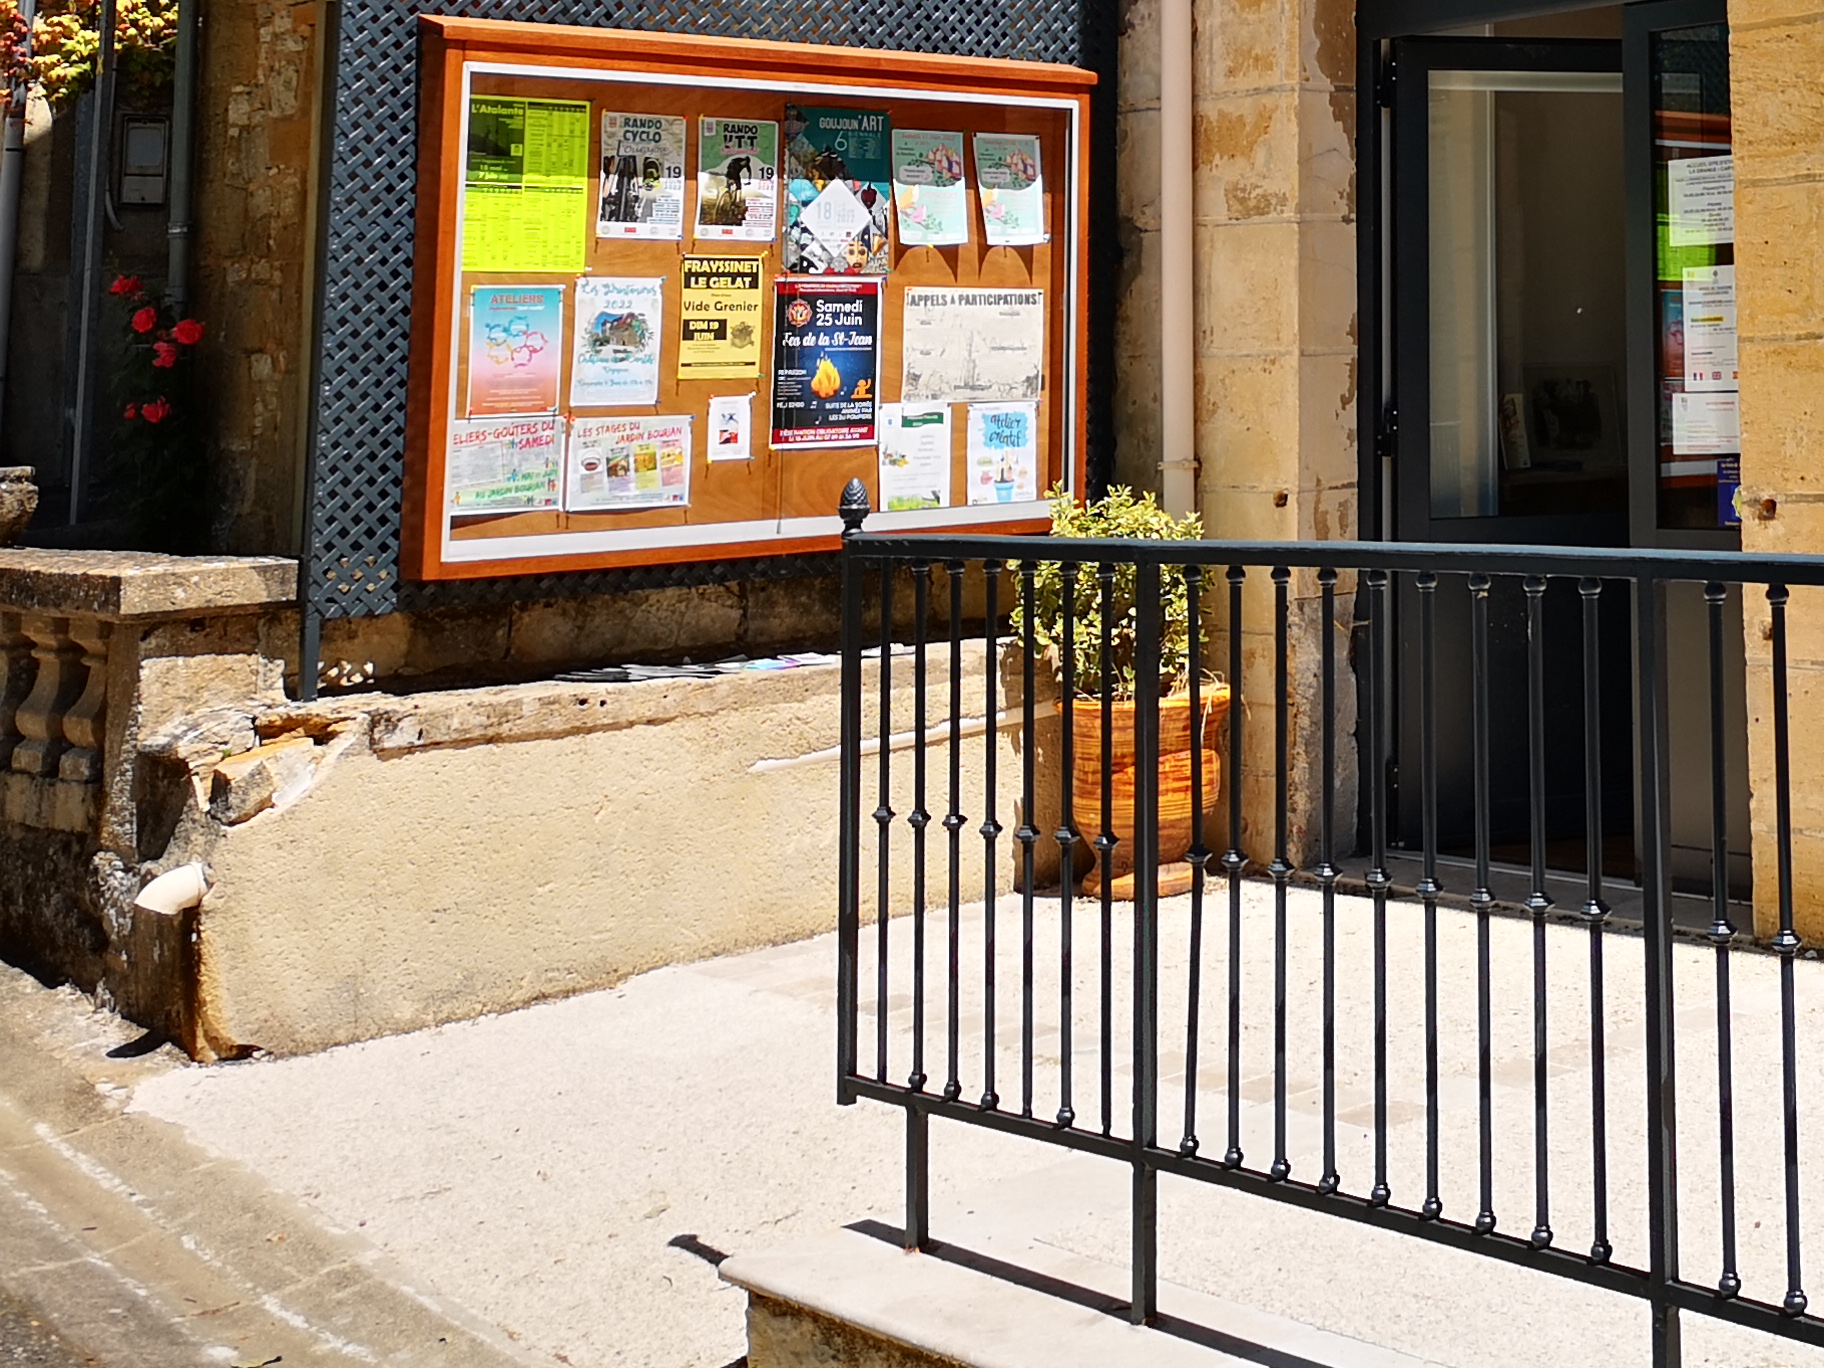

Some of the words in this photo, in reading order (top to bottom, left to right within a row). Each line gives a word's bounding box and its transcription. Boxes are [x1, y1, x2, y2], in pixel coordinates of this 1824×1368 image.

[623, 117, 662, 130] RANDO
[723, 123, 758, 134] RANDO
[623, 130, 661, 143] CYCLO
[723, 135, 758, 149] VTT
[835, 131, 847, 151] 6
[666, 165, 682, 179] 19
[759, 167, 774, 180] 19
[816, 202, 832, 220] 18
[684, 260, 758, 272] FRAYSSINET
[690, 276, 707, 288] LE
[709, 276, 752, 288] GELAT
[490, 294, 544, 304] ATELIERS
[603, 300, 633, 309] 2022
[909, 294, 948, 306] APPELS
[958, 293, 1038, 306] PARTICIPATIONS
[683, 301, 710, 311] Vide
[714, 301, 758, 311] Grenier
[816, 299, 863, 313] Samedi
[689, 321, 708, 330] DIM
[816, 314, 833, 326] 25
[835, 313, 863, 326] Juin
[693, 332, 715, 341] JUIN
[802, 332, 816, 347] de
[818, 332, 830, 347] la
[832, 331, 873, 347] St-Jean
[542, 420, 556, 432] DU
[577, 427, 593, 438] LES
[596, 423, 627, 436] STAGES
[629, 421, 641, 431] DU
[518, 434, 555, 450] SAMEDI
[615, 432, 645, 445] JARDIN
